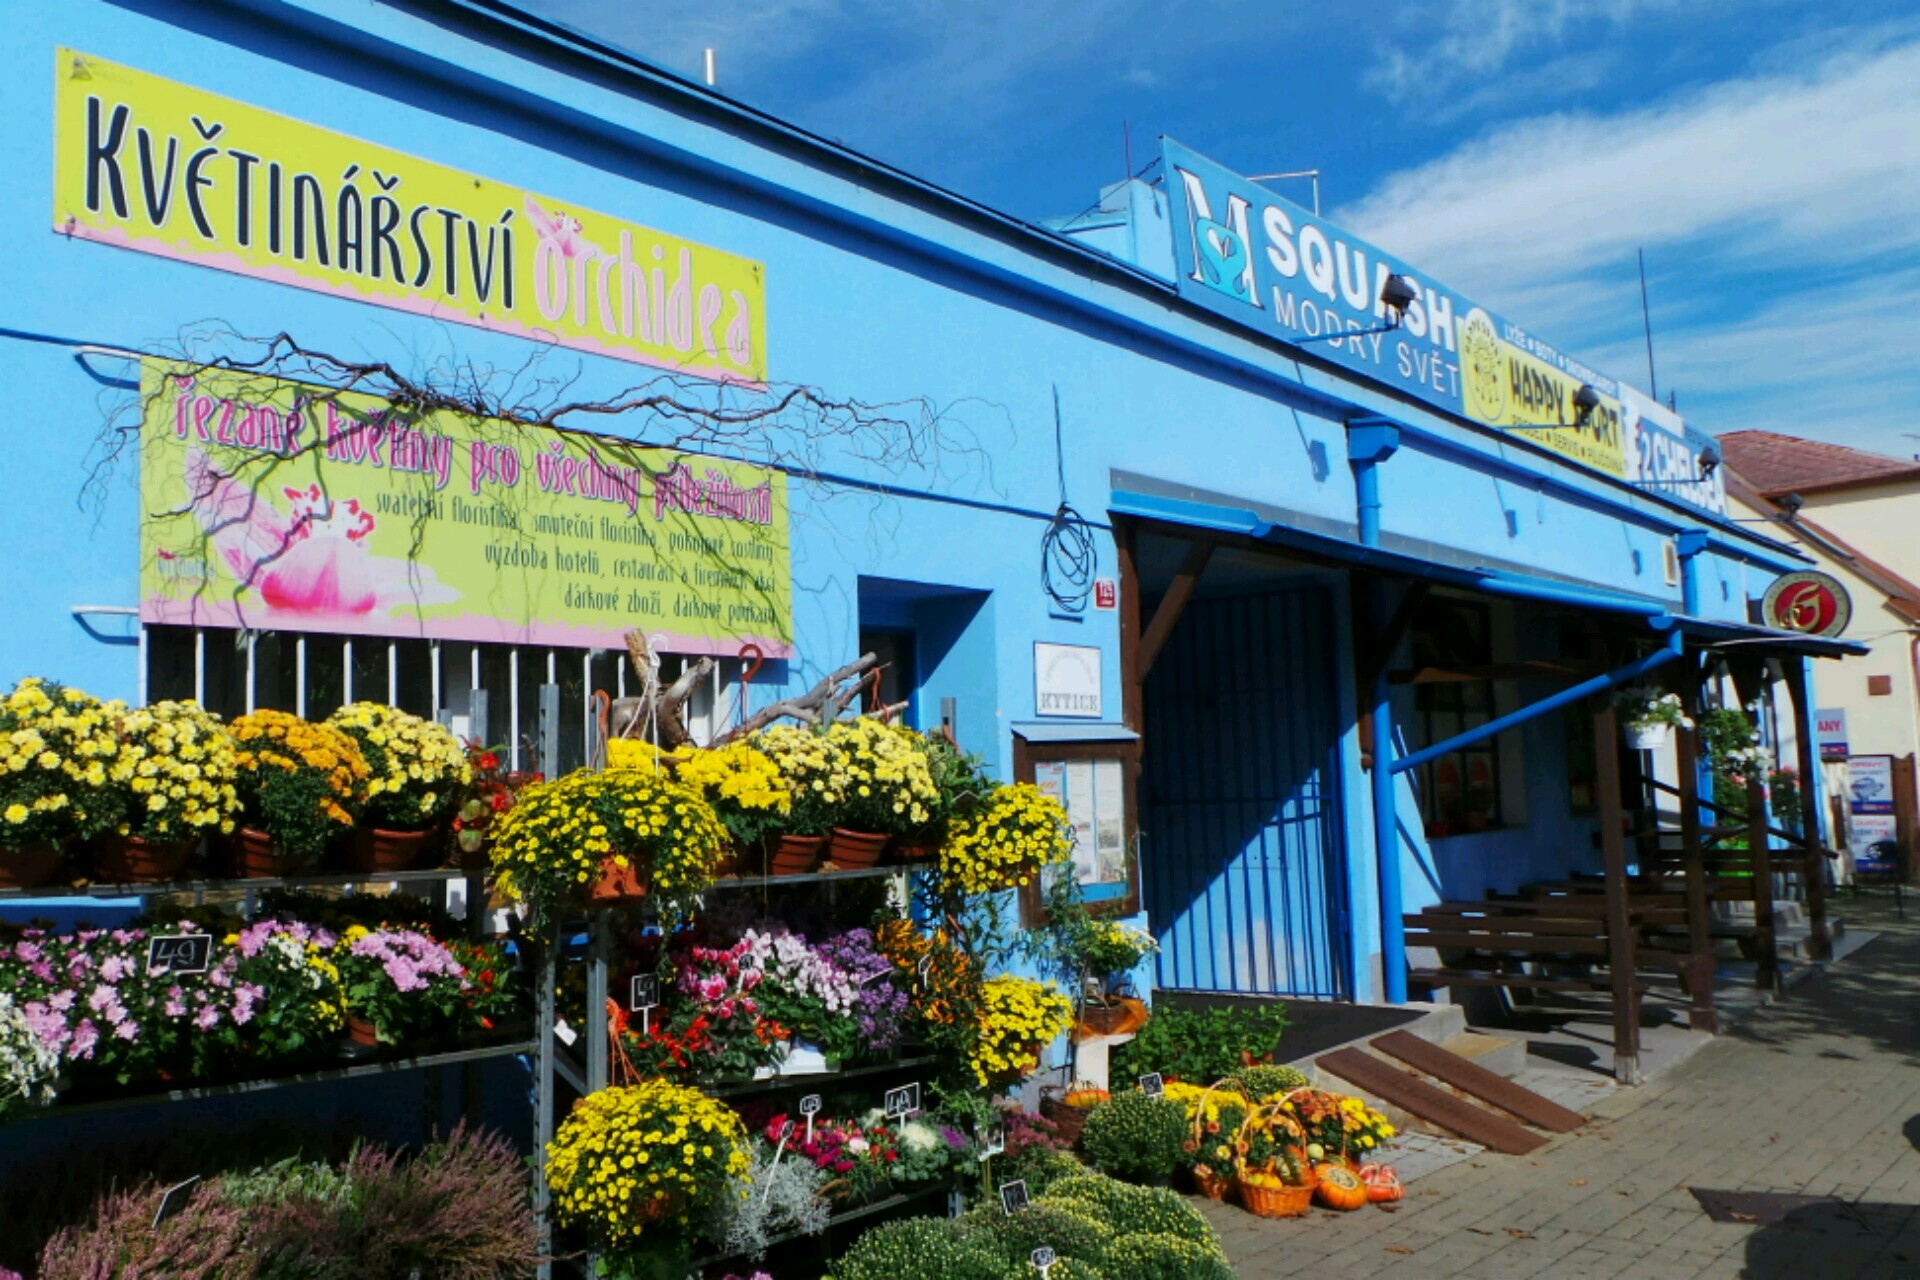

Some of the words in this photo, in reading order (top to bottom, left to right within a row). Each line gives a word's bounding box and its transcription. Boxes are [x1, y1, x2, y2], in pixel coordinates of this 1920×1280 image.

[86, 96, 514, 310] KVĚTINÁŘSTVÍ
[1271, 284, 1384, 365] MODRÝ
[1396, 341, 1459, 398] SVĚT
[1508, 356, 1564, 427] HAPPY
[175, 375, 305, 456] řezané
[326, 399, 453, 491] květiny
[470, 440, 518, 495] pro
[536, 440, 639, 517] všechny
[376, 488, 444, 521] svatební
[485, 538, 549, 571] výzdoba
[556, 545, 606, 579] hotelů,
[564, 582, 620, 612] dárkové
[627, 587, 665, 619] zboží,
[155, 939, 196, 967] 49
